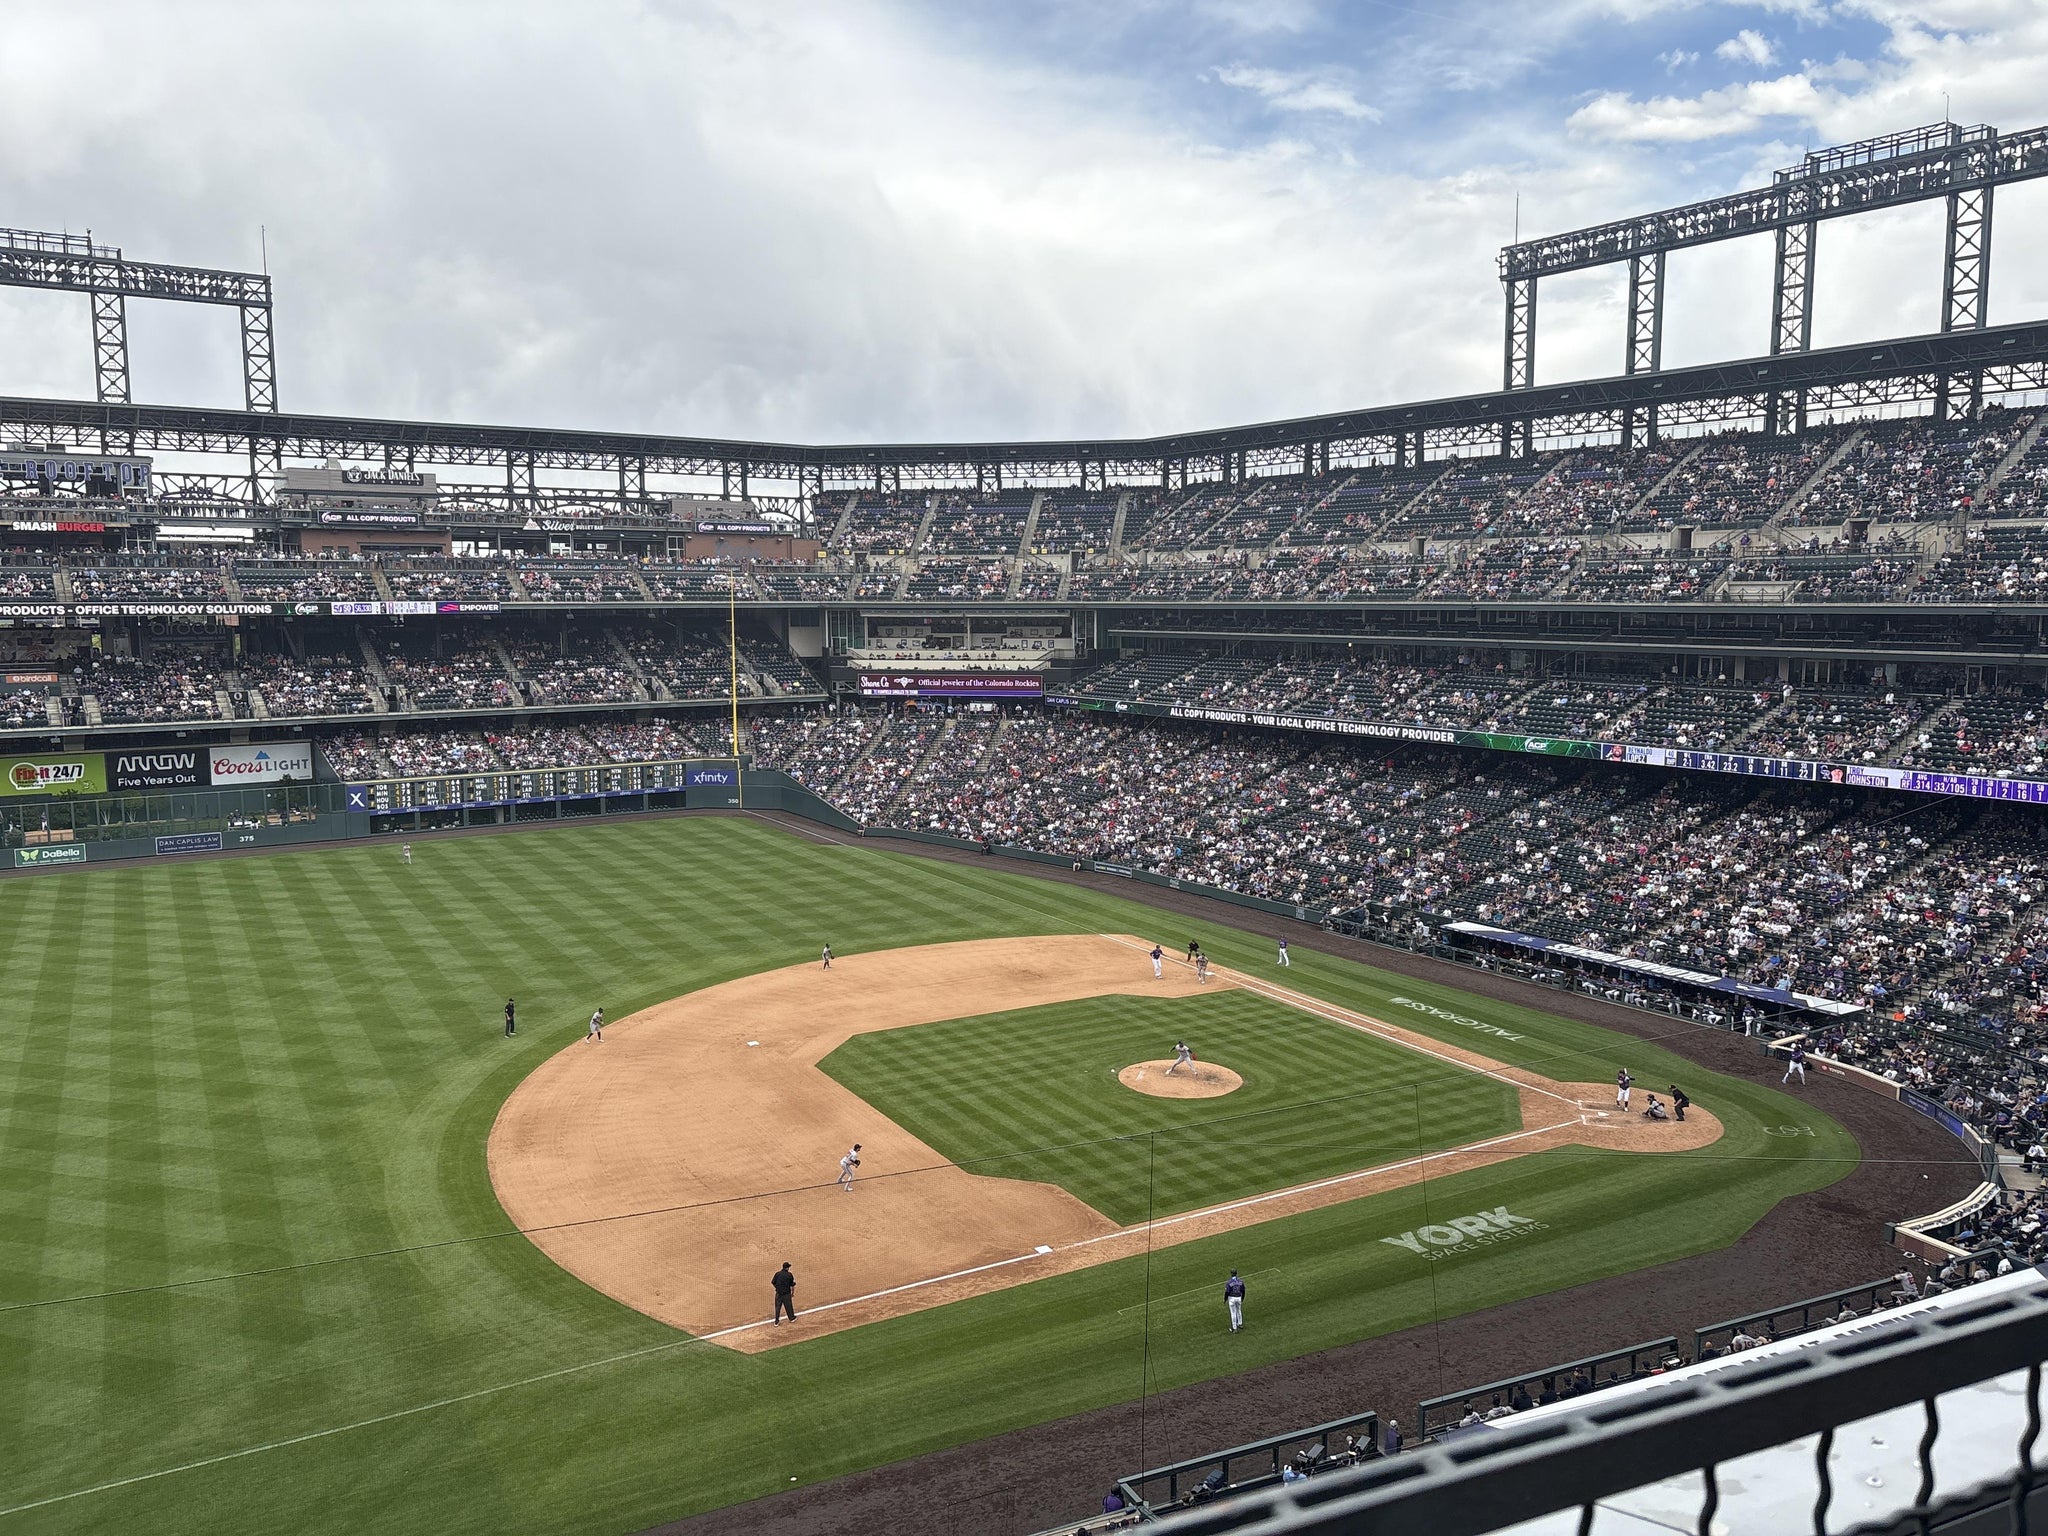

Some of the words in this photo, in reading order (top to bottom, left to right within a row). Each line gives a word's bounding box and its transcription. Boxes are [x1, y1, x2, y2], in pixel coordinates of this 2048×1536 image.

[25, 460, 152, 482] ROOFTOP
[365, 468, 386, 480] JACK
[13, 522, 105, 532] SMASHBURGER
[542, 520, 575, 531] Silver
[75, 605, 119, 615] OFFICE
[121, 605, 204, 615] TECHNOLOGY
[206, 605, 272, 614] SOLUTIONS
[20, 675, 52, 683] birdcall
[942, 679, 964, 688] Jeweler
[234, 692, 242, 701] O
[1170, 708, 1183, 717] ALL
[1184, 709, 1204, 719] COPY
[1205, 710, 1246, 723] PRODUCTS
[1253, 715, 1275, 726] YOUR
[1277, 717, 1303, 728] LOCAL
[1305, 720, 1336, 731] OFFICE
[1337, 722, 1401, 738] TECHNOLOGY
[1402, 728, 1454, 742] PROVIDER
[117, 753, 196, 773] ARROW
[213, 759, 264, 775] Coors
[265, 759, 309, 772] LIGHT
[1701, 760, 1716, 769] 3.42
[1723, 762, 1738, 772] 23.2
[16, 767, 50, 780] Fix-it
[53, 765, 83, 778] 24/7
[1748, 764, 1753, 773] 9
[1764, 766, 1769, 775] 4
[1780, 768, 1788, 777] 11
[1850, 767, 1865, 775] TROY
[694, 772, 728, 784] xfinity
[1799, 769, 1808, 779] 22
[118, 776, 141, 787] Five
[143, 775, 174, 786] Years
[176, 774, 196, 784] Out
[1848, 775, 1886, 787] JOHNSTON
[1902, 780, 1911, 788] RF
[1914, 781, 1931, 790] .314
[1934, 782, 1965, 794] 33/105
[1972, 786, 1977, 794] 8
[1987, 787, 1992, 796] 0
[2002, 789, 2007, 798] 2
[2018, 790, 2027, 799] 16
[2038, 792, 2042, 801] 1
[350, 793, 365, 808] X
[42, 849, 80, 859] DaBella
[1405, 1002, 1526, 1042] TALLGRASS
[1378, 1206, 1536, 1254] YORK
[1421, 1242, 1479, 1262] SPACE
[1477, 1222, 1550, 1246] SYSTEMS
